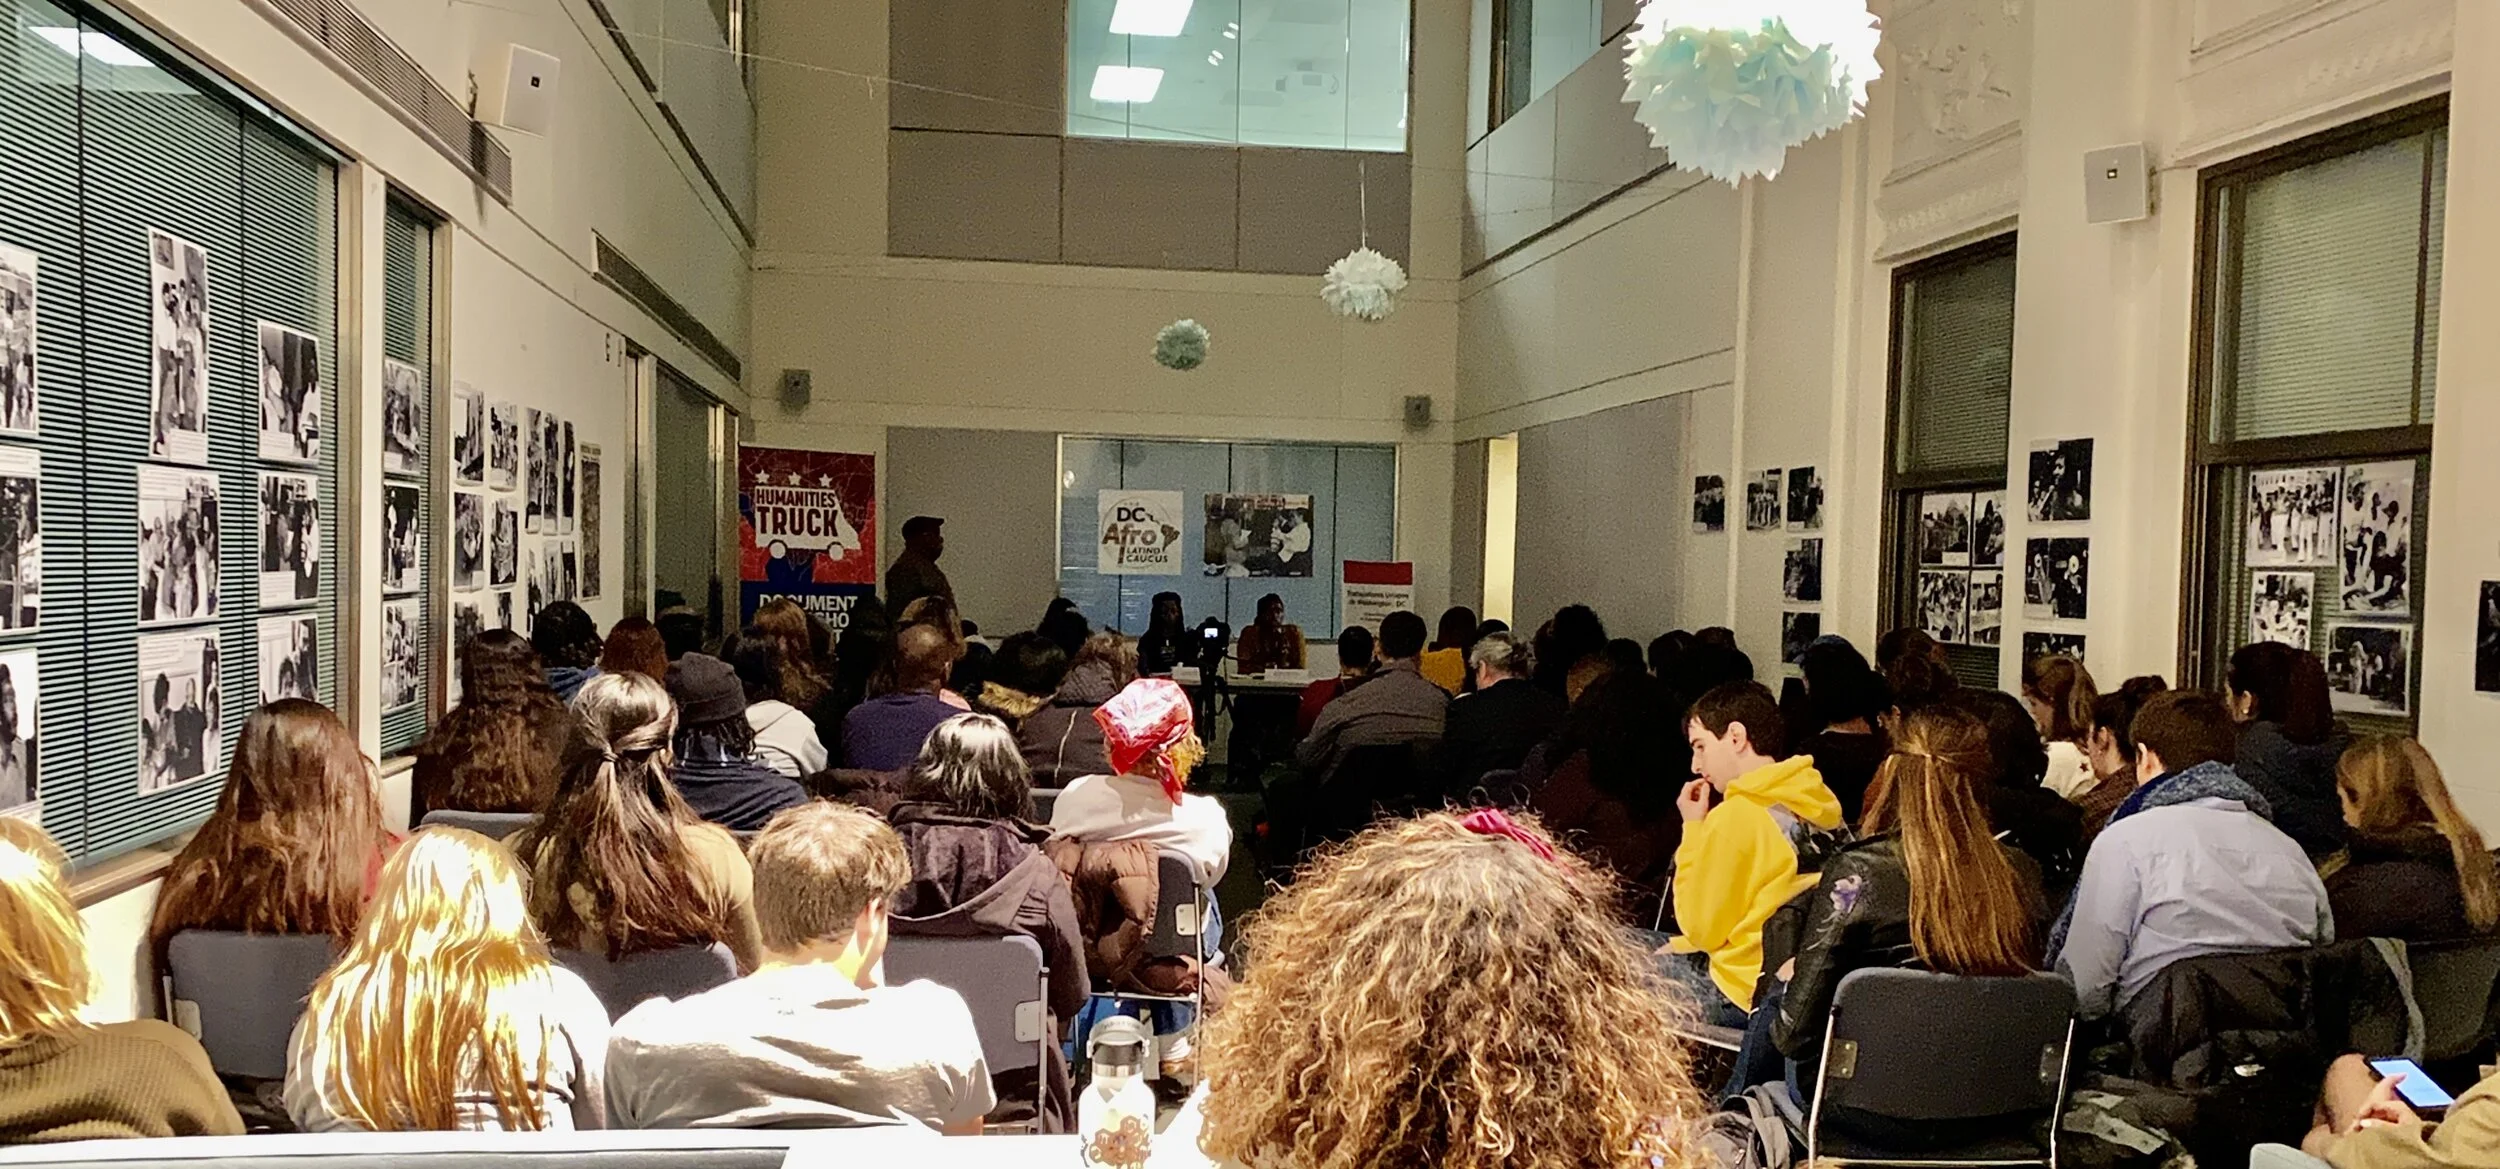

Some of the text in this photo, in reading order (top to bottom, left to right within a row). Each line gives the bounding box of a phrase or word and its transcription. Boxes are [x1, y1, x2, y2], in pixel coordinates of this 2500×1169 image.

[756, 488, 836, 508] HUMANITIES
[757, 506, 838, 537] TRUCK
[1117, 507, 1145, 522] DC
[1102, 523, 1157, 564] Afro
[1126, 555, 1168, 563] CAUCUS
[759, 594, 858, 611] DUMENT
